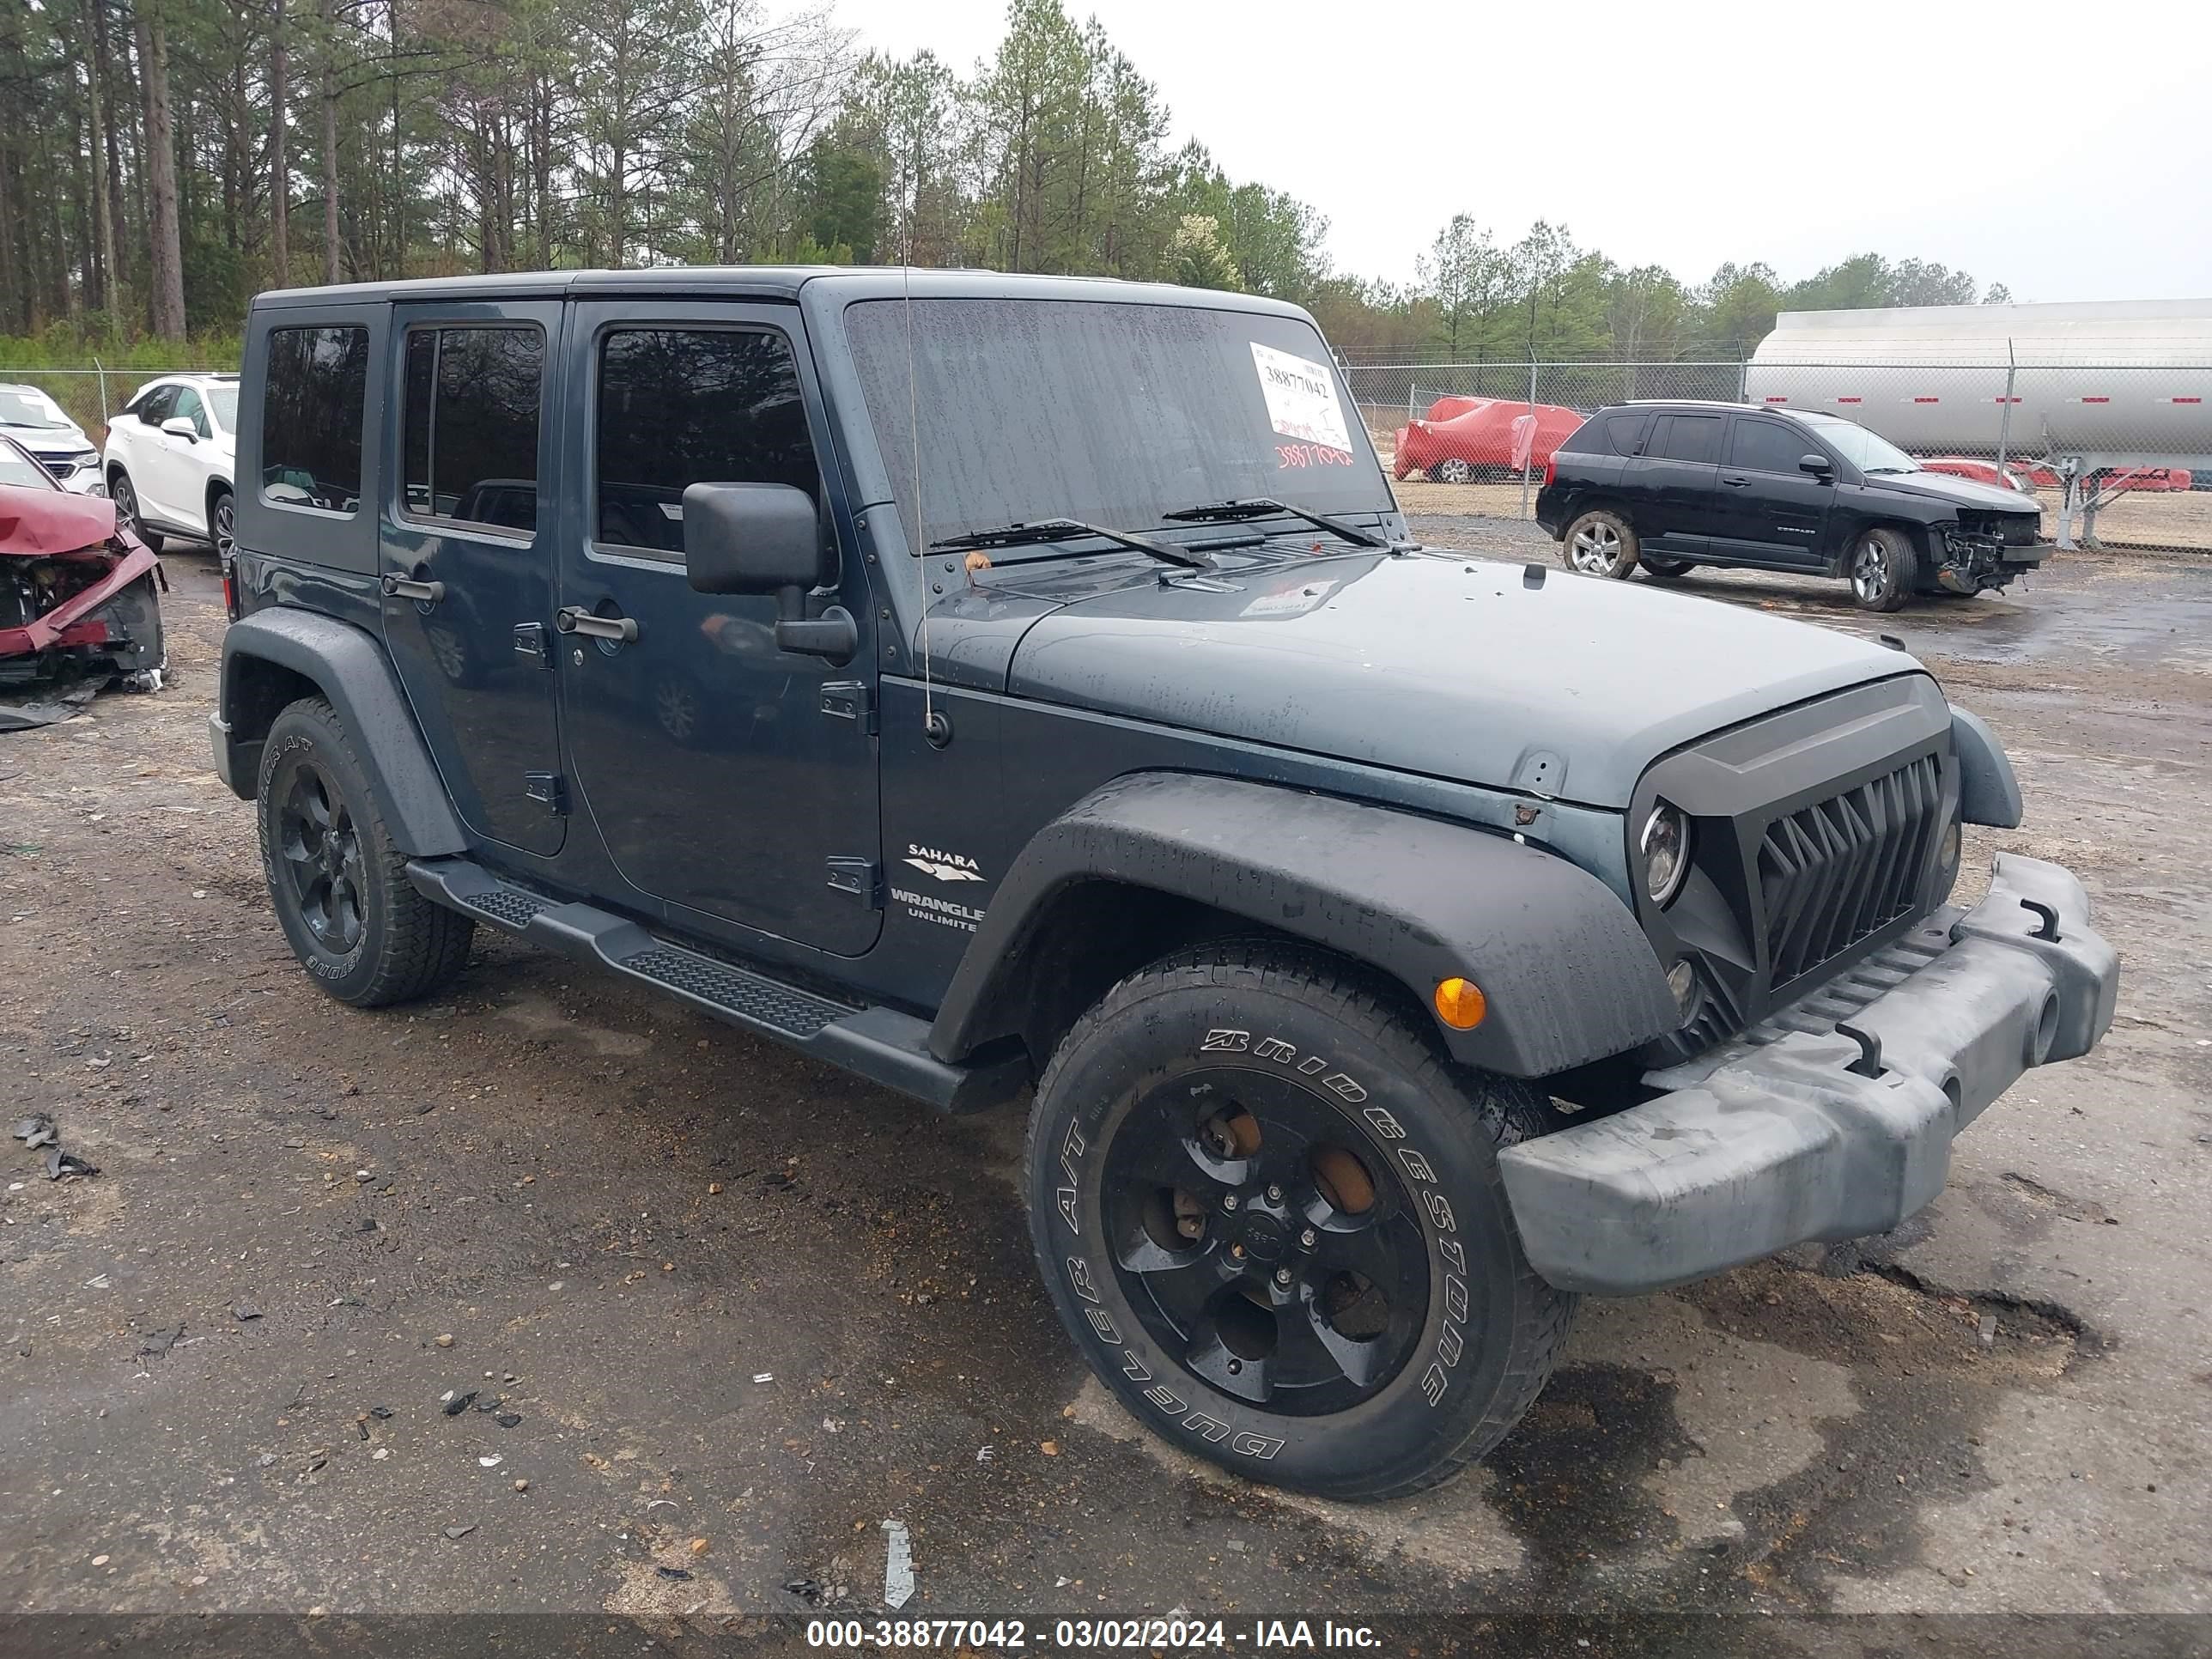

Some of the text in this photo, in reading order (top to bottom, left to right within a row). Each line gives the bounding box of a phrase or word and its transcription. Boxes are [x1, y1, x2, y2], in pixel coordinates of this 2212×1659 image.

[1264, 366, 1328, 398] 38877042
[1274, 444, 1354, 469] 38877042
[908, 843, 980, 871] SAHARA
[890, 888, 986, 921] WRANGLE
[908, 908, 977, 933] UNLIMITE
[1200, 1029, 1468, 1407] BRIDGESTONE
[1057, 1117, 1285, 1460] DUELER A/T
